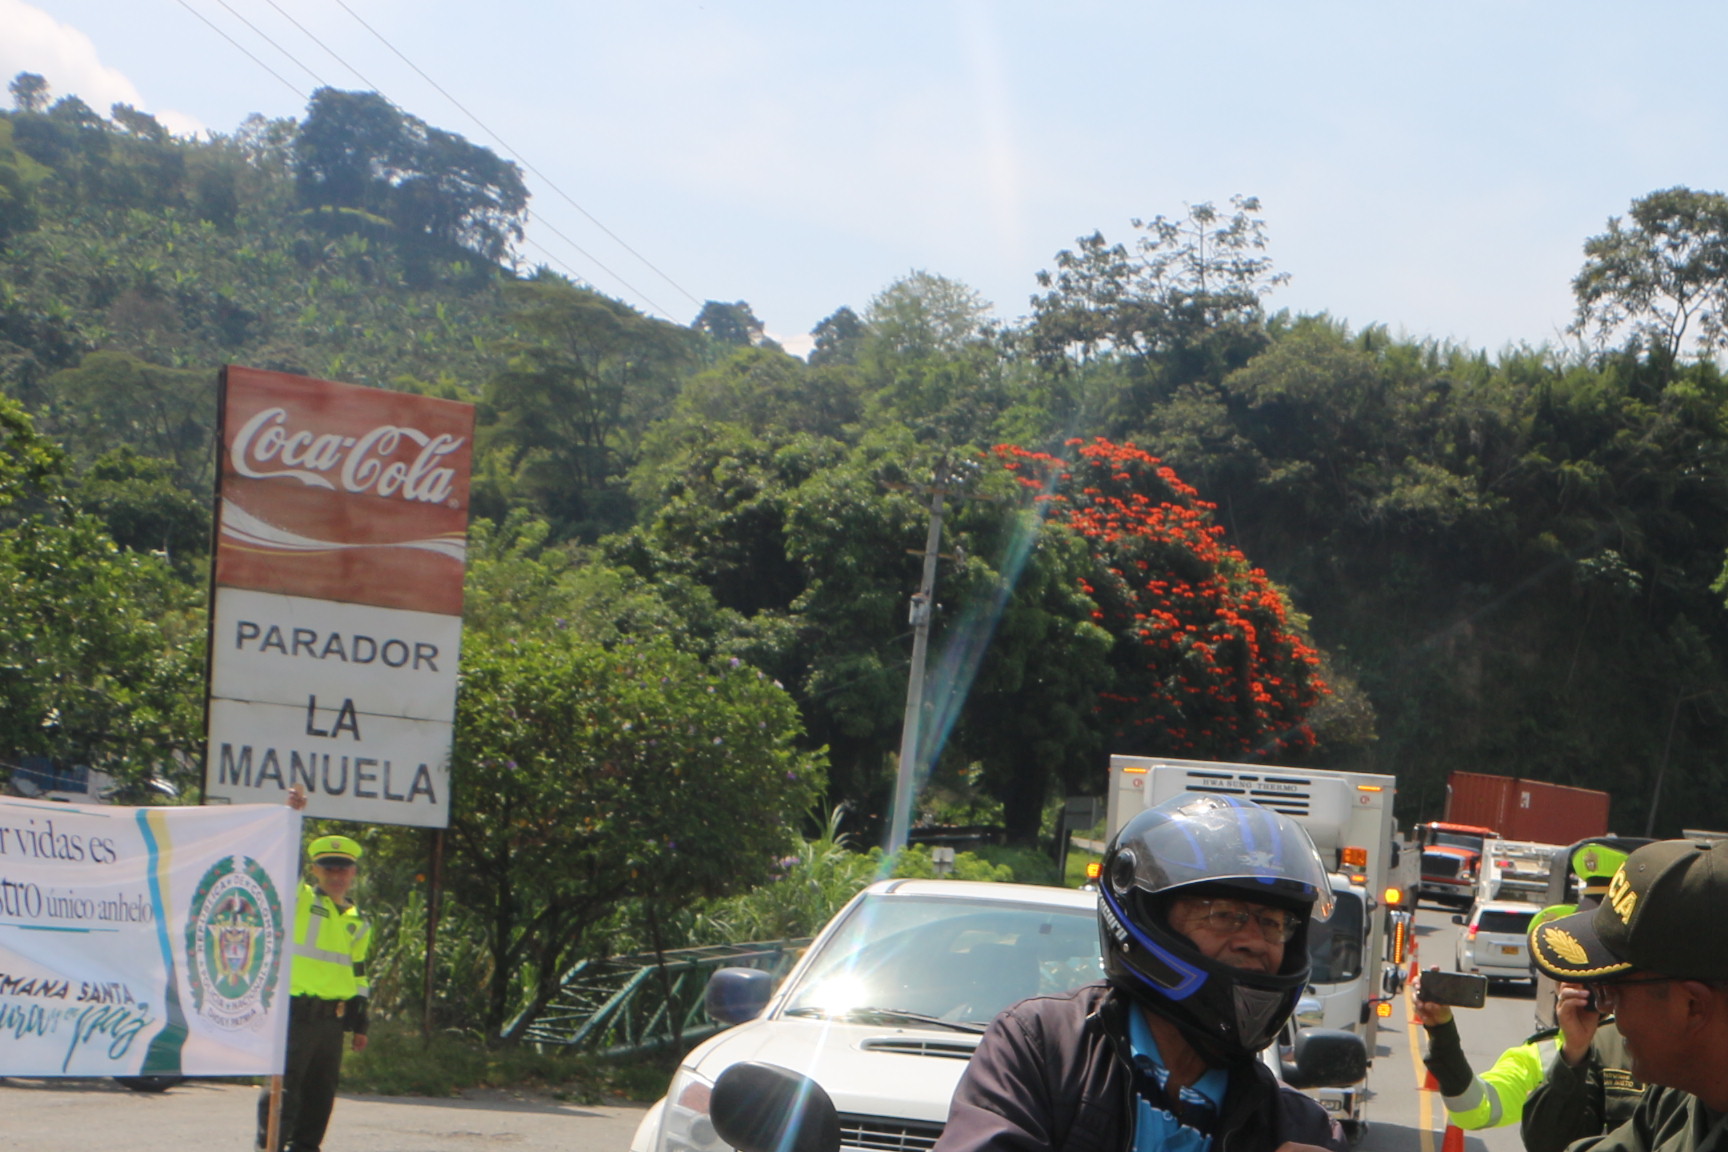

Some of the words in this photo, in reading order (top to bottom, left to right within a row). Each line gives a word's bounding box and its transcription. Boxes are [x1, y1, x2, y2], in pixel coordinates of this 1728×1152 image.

[231, 407, 464, 504] Coca-Cola
[235, 621, 440, 672] PARADOR
[306, 694, 361, 742] LA
[218, 742, 437, 805] MANUELA
[1226, 780, 1252, 788] SUNG
[1257, 783, 1298, 792] THERMO
[15, 819, 85, 862] vidas
[89, 836, 117, 864] es
[0, 877, 41, 919] tro
[46, 888, 94, 919] único
[98, 892, 152, 923] anhelo
[1608, 862, 1638, 926] CIA
[0, 974, 69, 999] MANA
[77, 981, 136, 1005] SANTA
[62, 1002, 155, 1073] paz
